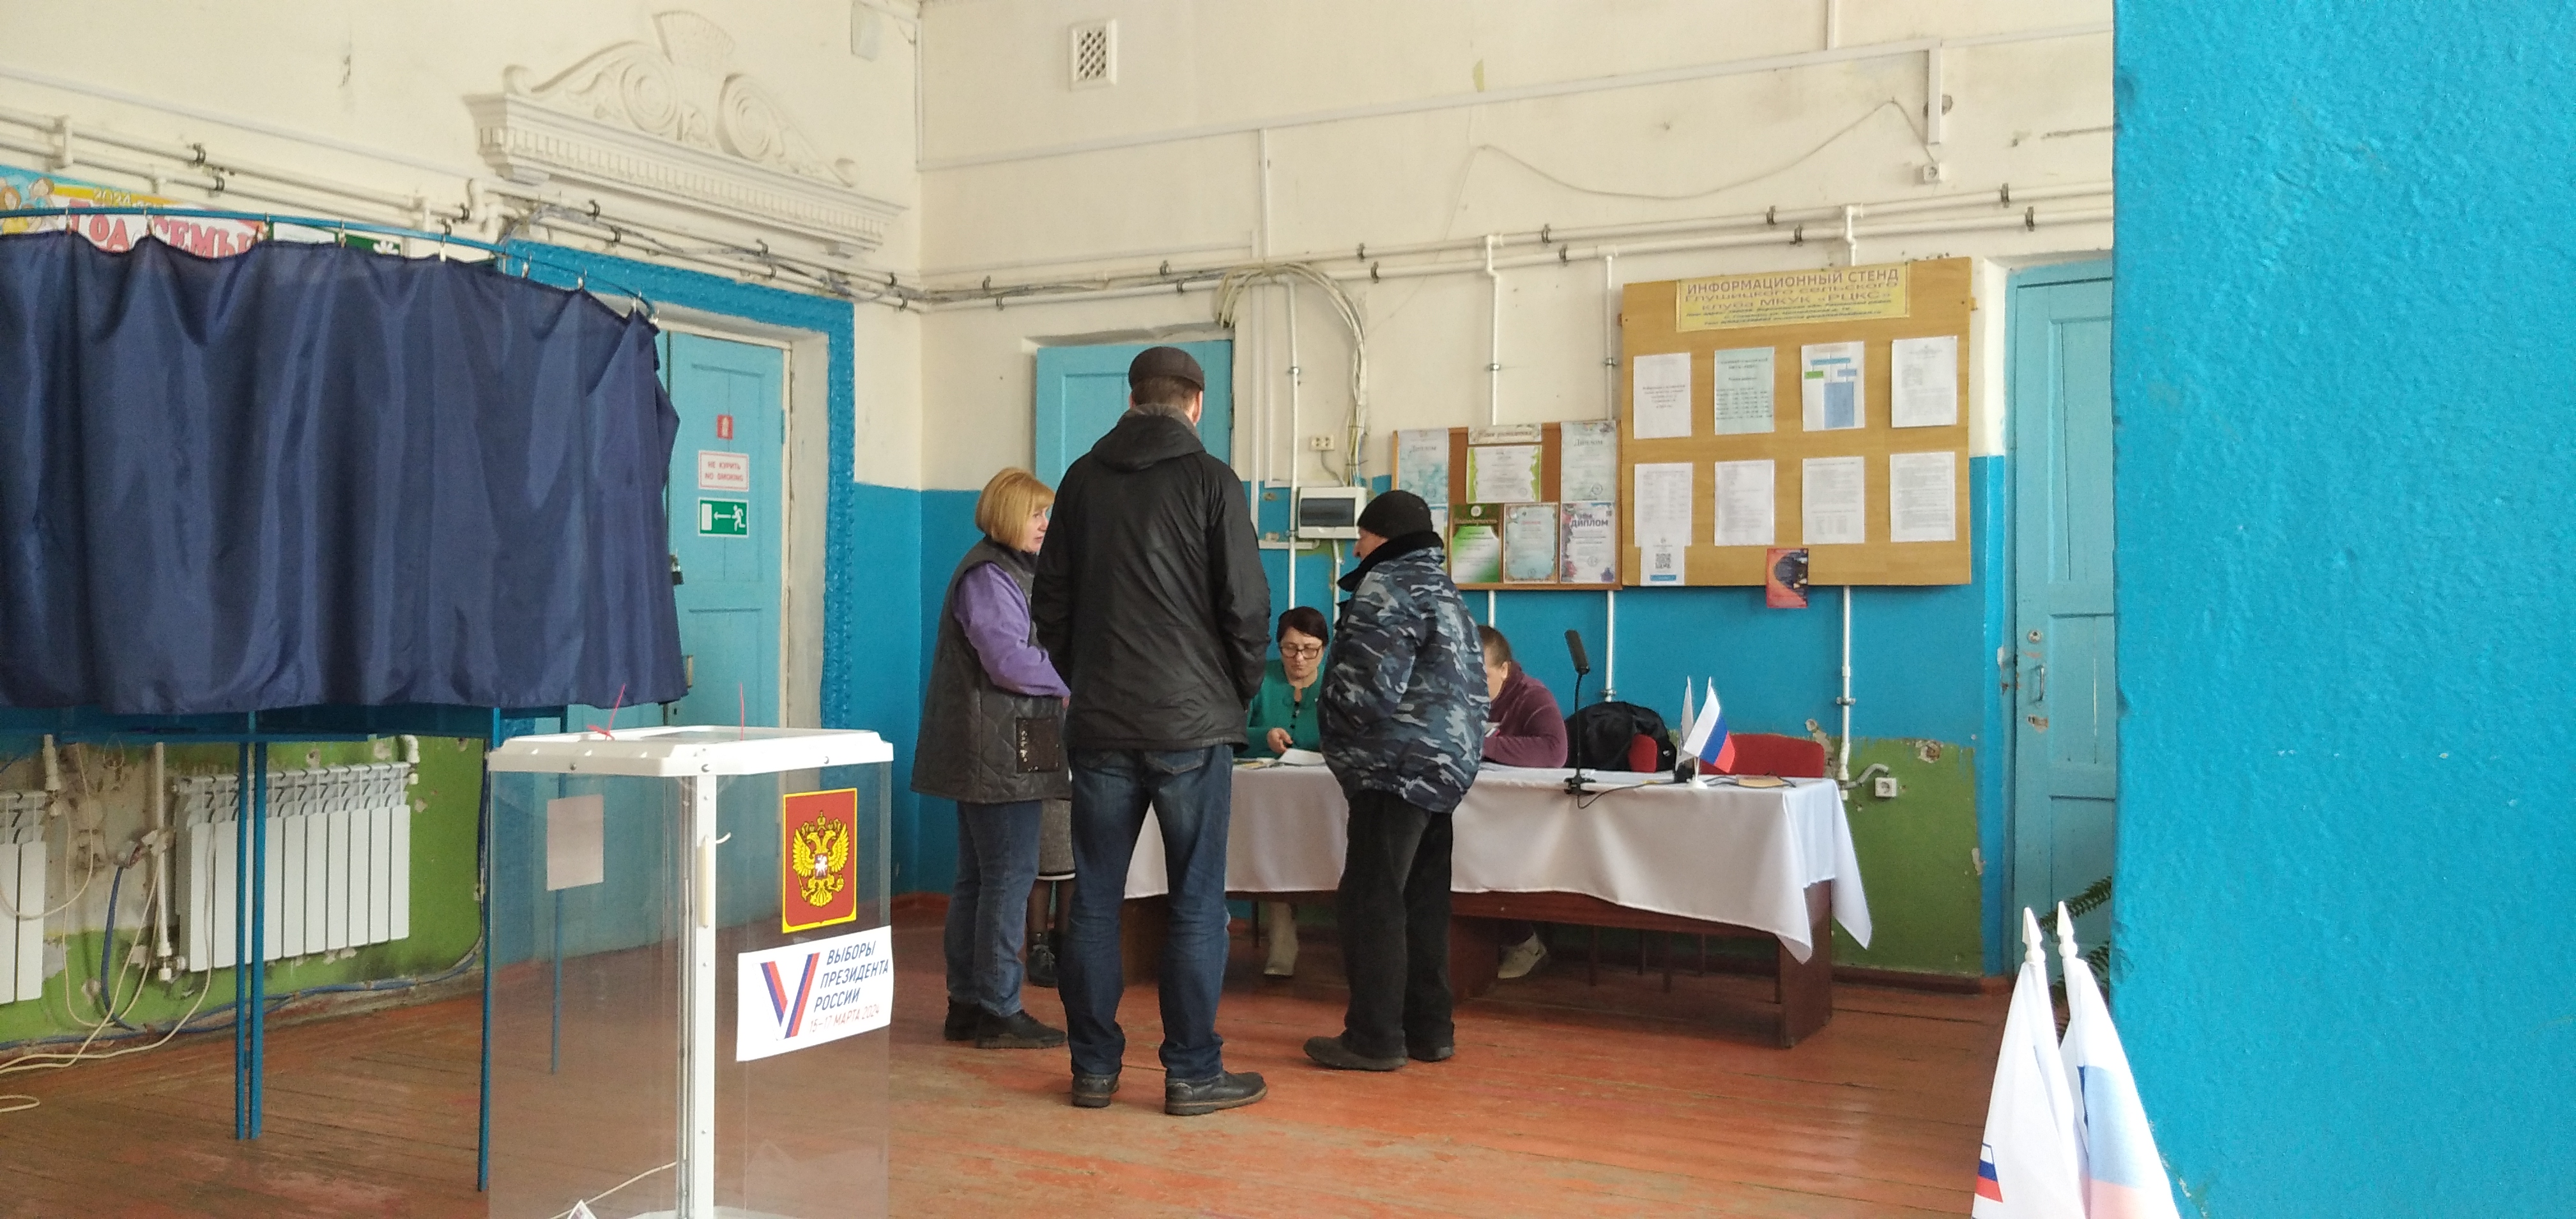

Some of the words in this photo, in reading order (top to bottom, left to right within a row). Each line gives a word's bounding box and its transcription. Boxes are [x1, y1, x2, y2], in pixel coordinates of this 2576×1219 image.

[68, 199, 130, 252] ГОД
[1687, 270, 1842, 295] ИНФОРМАЦИОННЫЙ
[1848, 268, 1899, 285] СТЕНД
[1760, 296, 1810, 306] МКУК
[717, 473, 744, 482] SMOKING
[826, 940, 877, 966] ВЫБОРЫ
[820, 958, 889, 989] ПРЕЗИДЕНТА
[813, 987, 861, 1013] РОССИИ
[833, 1008, 861, 1027] МАРТА
[861, 1004, 880, 1020] 2024
